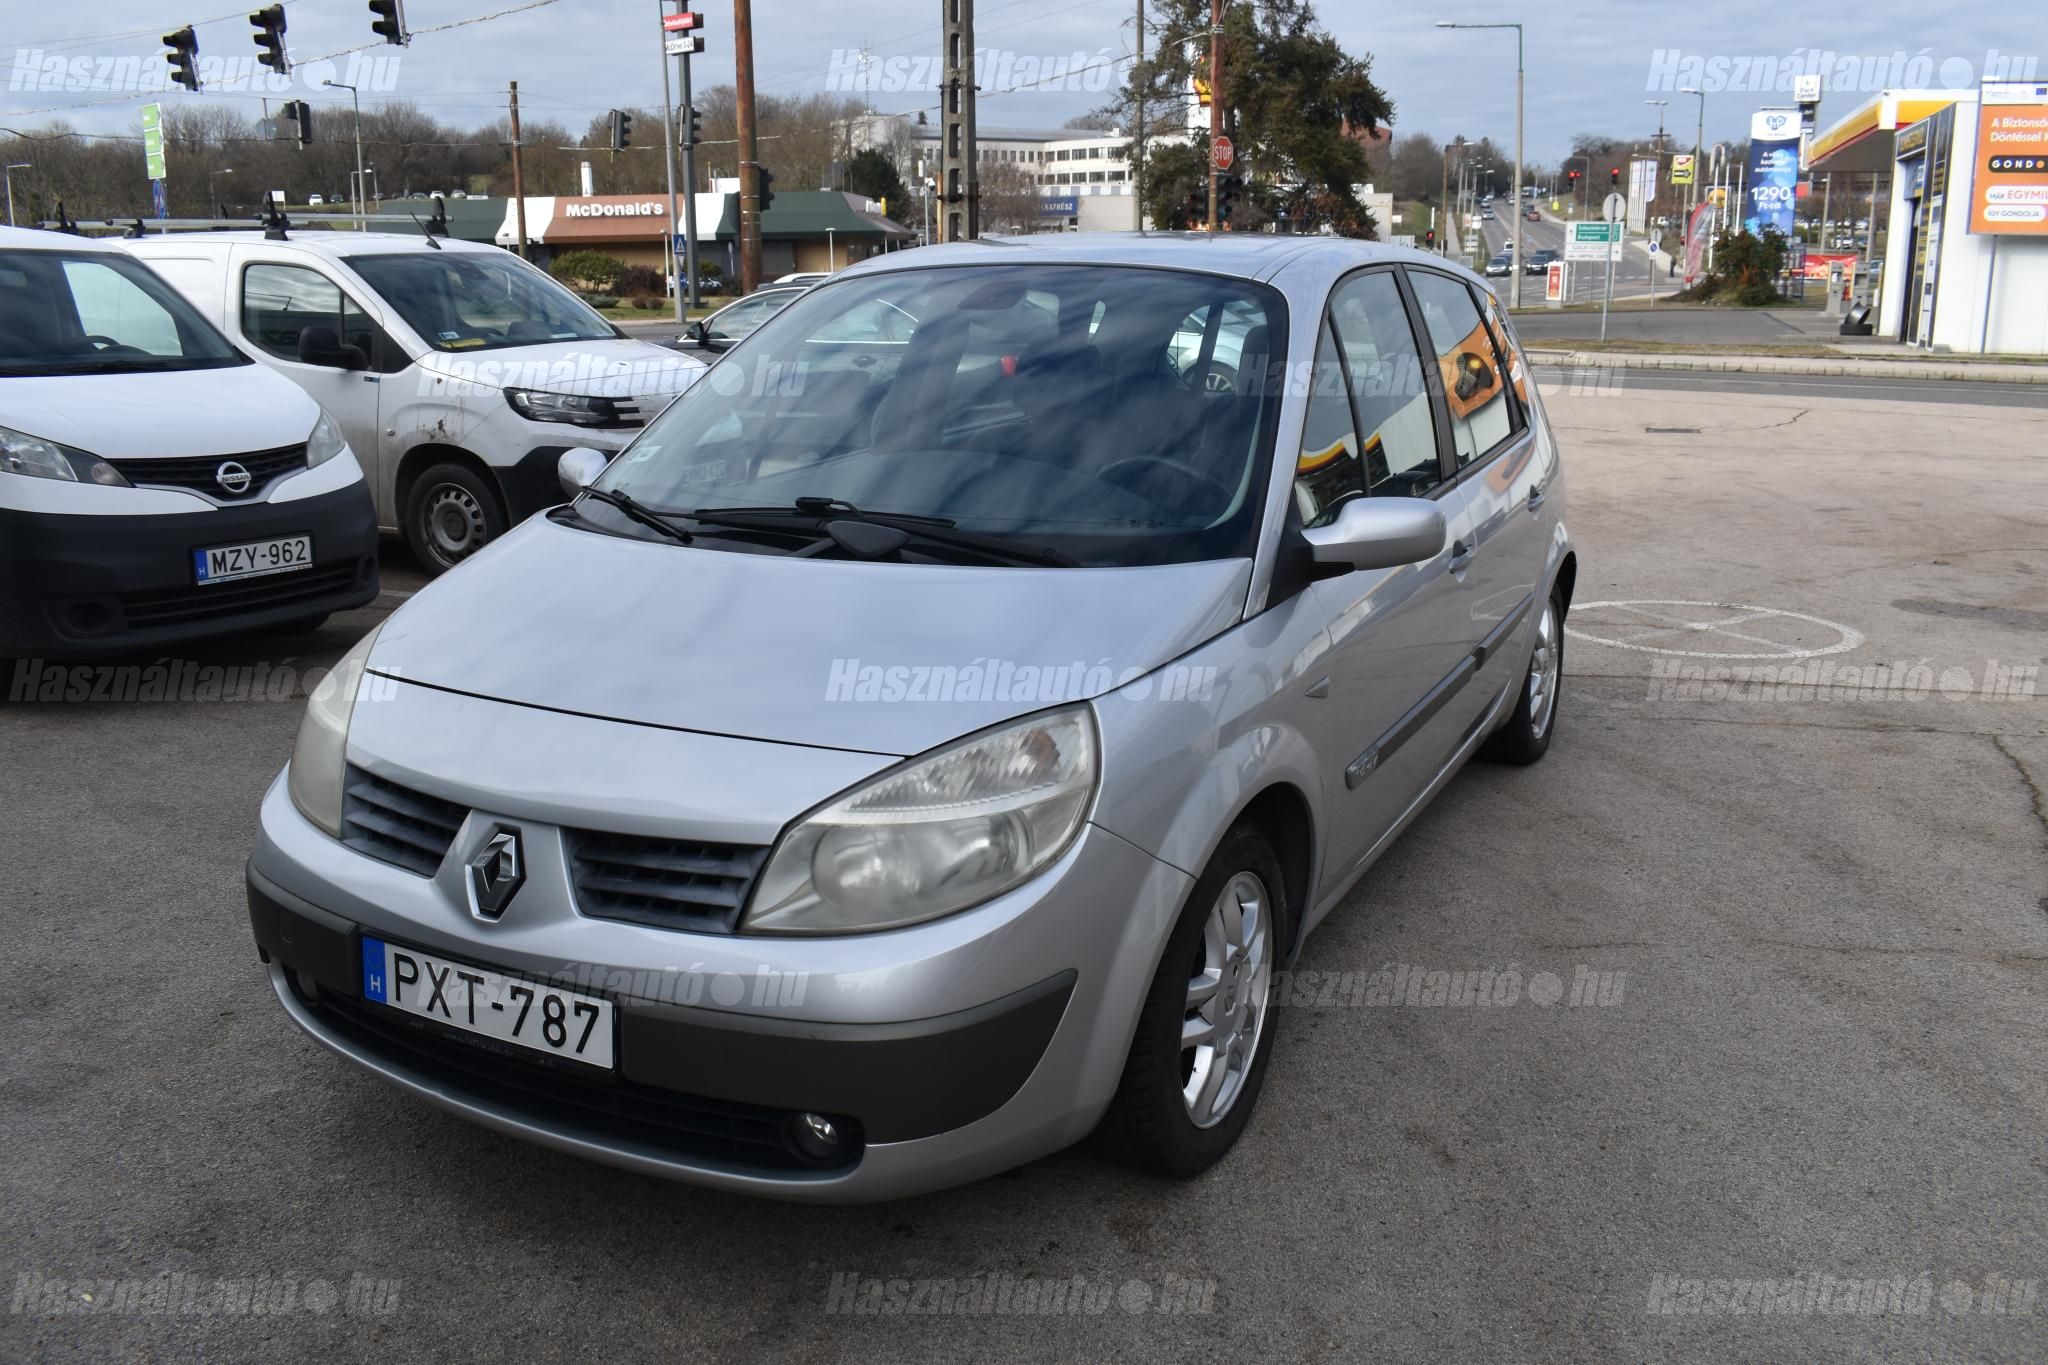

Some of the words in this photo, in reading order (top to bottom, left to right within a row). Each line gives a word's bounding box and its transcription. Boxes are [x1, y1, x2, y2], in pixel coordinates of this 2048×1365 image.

[1991, 118, 2000, 128] A
[1991, 131, 2042, 142] Döntéssel
[1214, 146, 1232, 160] STOP
[1751, 186, 1791, 201] 1290
[566, 202, 664, 217] McDonald's
[221, 474, 250, 482] NISSAN
[211, 539, 307, 575] MZY-962
[370, 974, 382, 994] H
[394, 952, 600, 1054] PXT-787
